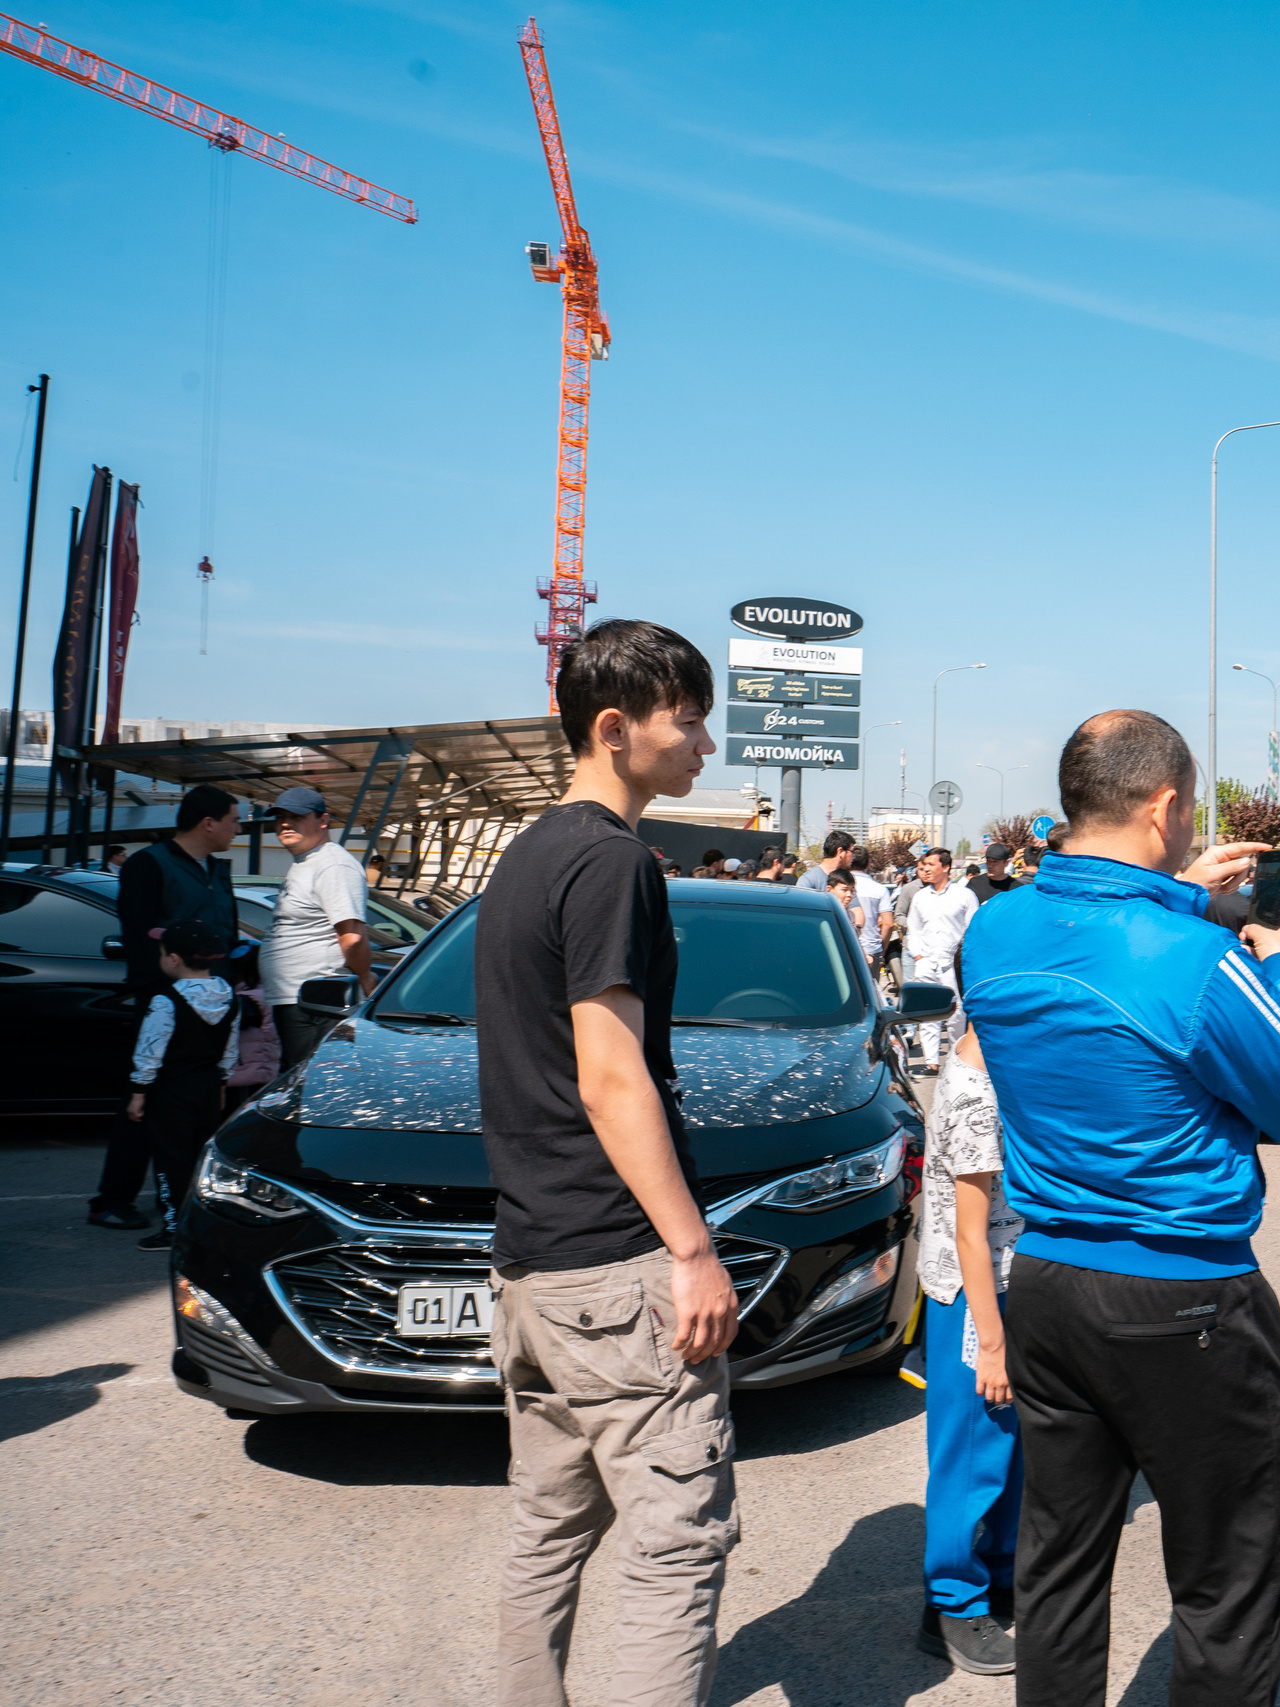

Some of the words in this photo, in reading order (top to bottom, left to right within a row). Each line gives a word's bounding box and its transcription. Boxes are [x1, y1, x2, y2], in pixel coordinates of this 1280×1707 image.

[744, 606, 851, 628] EVOLUTION
[773, 648, 836, 661] EVOLUTION
[757, 689, 770, 698] 24
[742, 745, 844, 763] АВТОМОЙКА
[413, 1297, 447, 1325] 01
[456, 1292, 481, 1328] A
